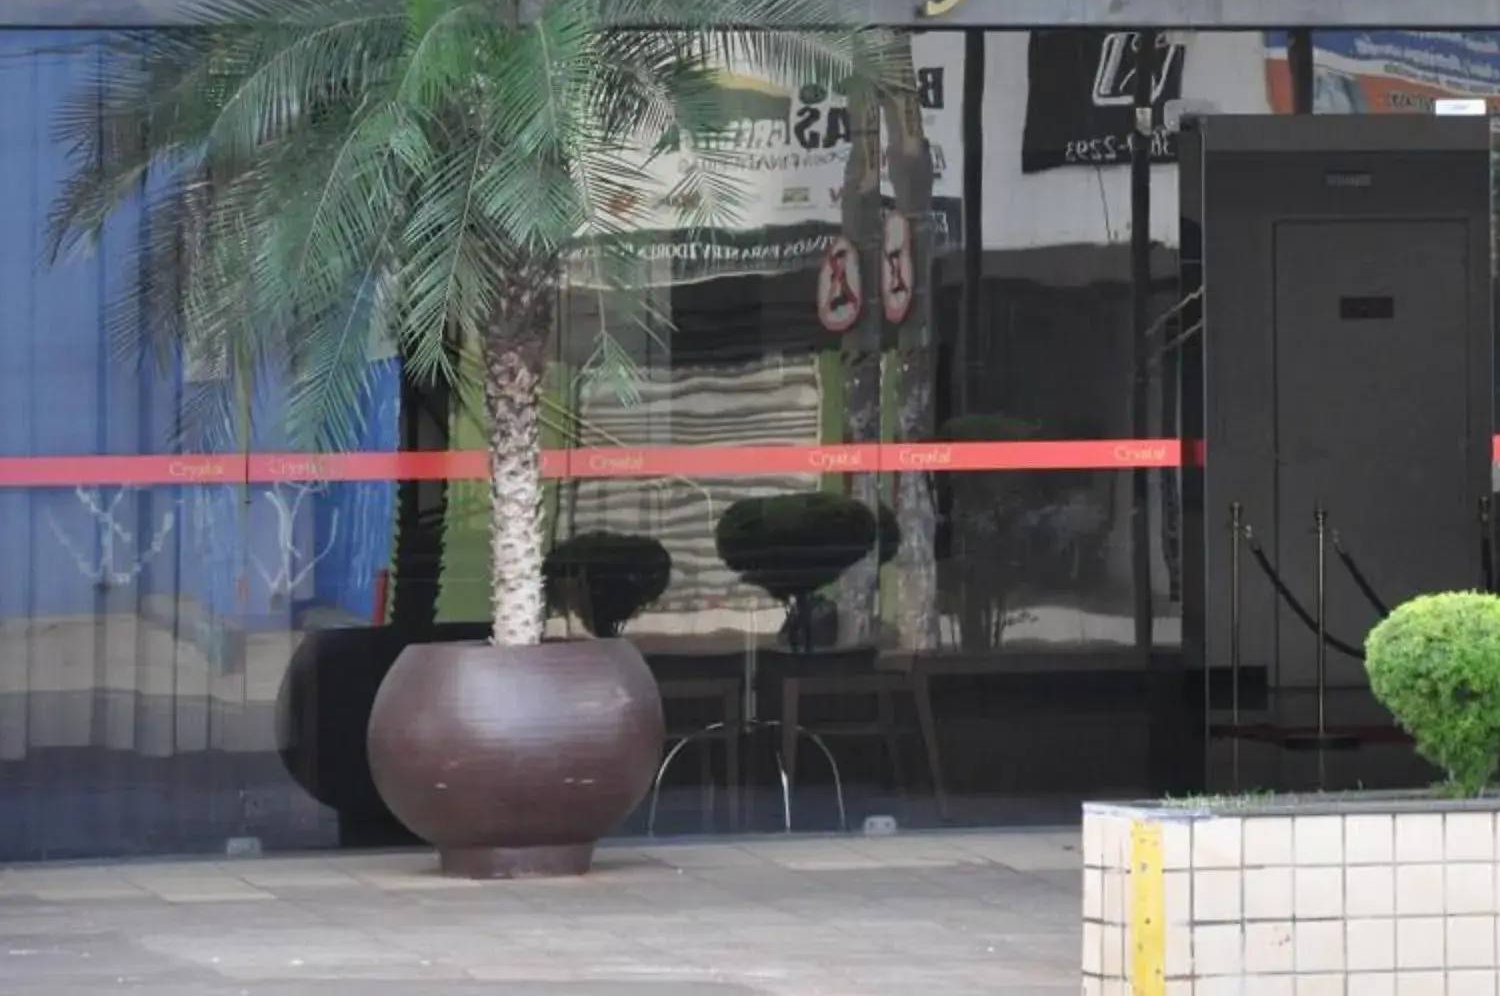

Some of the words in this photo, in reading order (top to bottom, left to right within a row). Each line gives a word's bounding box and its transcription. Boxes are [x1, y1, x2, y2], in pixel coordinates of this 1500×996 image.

[809, 450, 861, 468] Crystal
[899, 447, 952, 466] Crystal
[1113, 445, 1167, 463] Crystal
